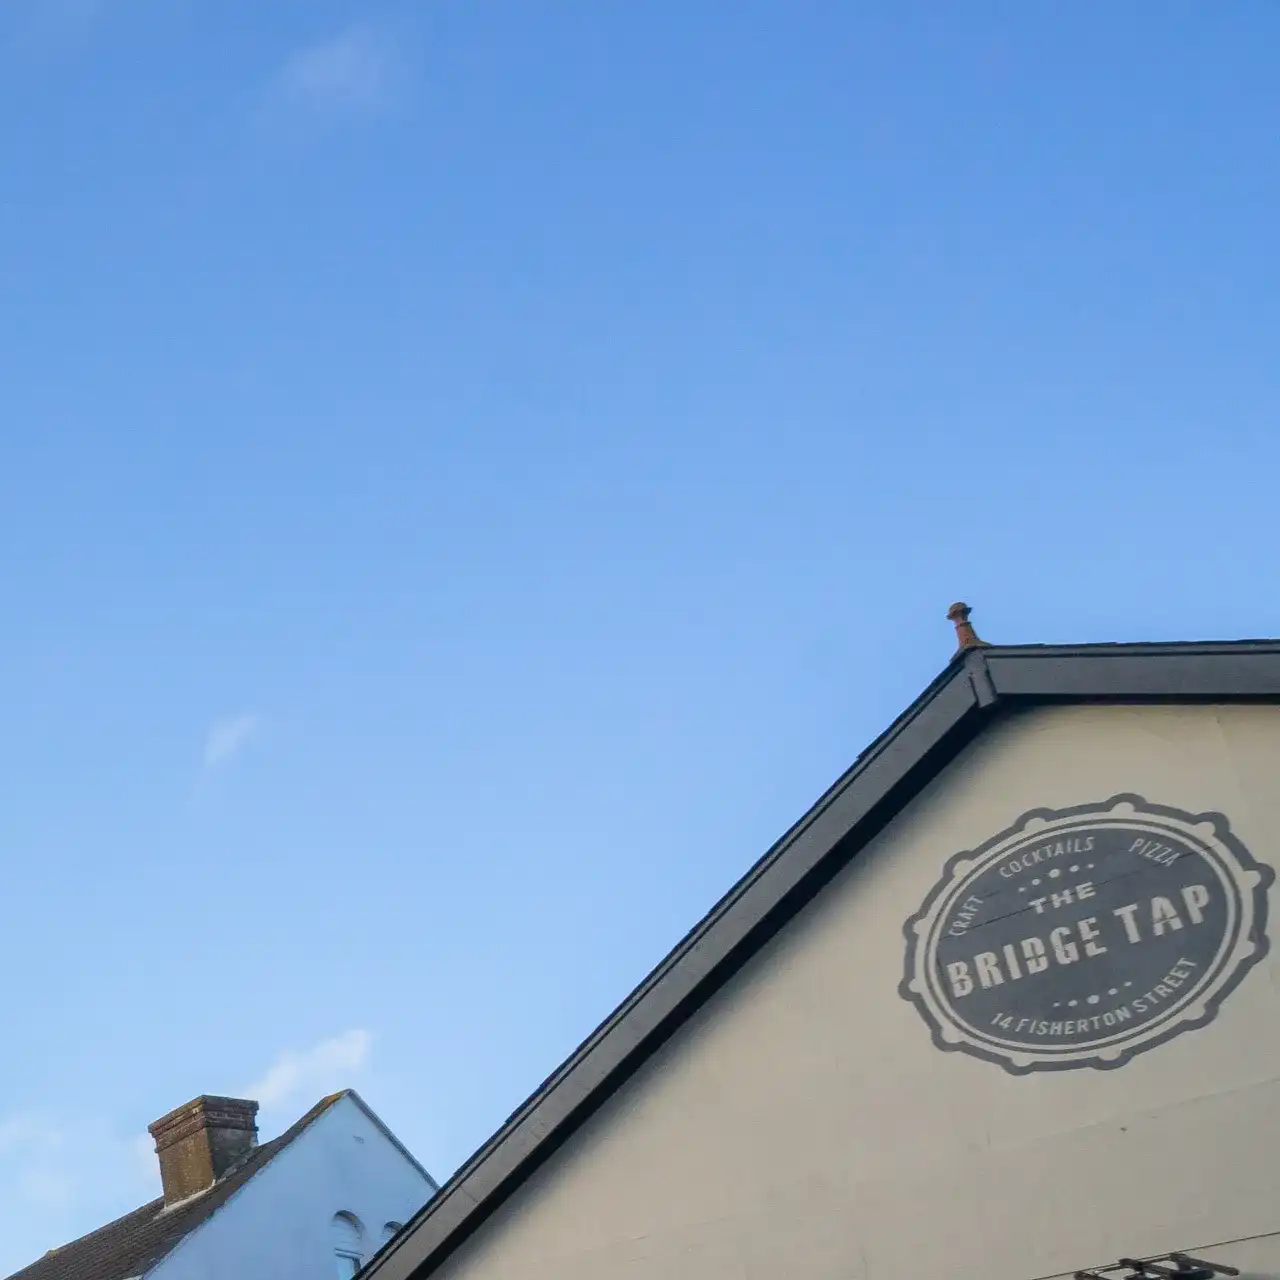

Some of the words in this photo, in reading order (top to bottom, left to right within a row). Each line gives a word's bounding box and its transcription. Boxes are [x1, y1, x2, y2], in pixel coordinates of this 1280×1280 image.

[948, 893, 985, 938] CRAFT
[999, 836, 1095, 880] COCKTAILS
[1128, 837, 1182, 868] PIZZA
[1028, 881, 1097, 915] THE
[947, 916, 1108, 998] BRIDGE
[1113, 884, 1212, 946] TAP
[990, 1011, 1012, 1030] 14
[1014, 1006, 1132, 1036] FISHERTON
[1132, 956, 1199, 1014] STREET
